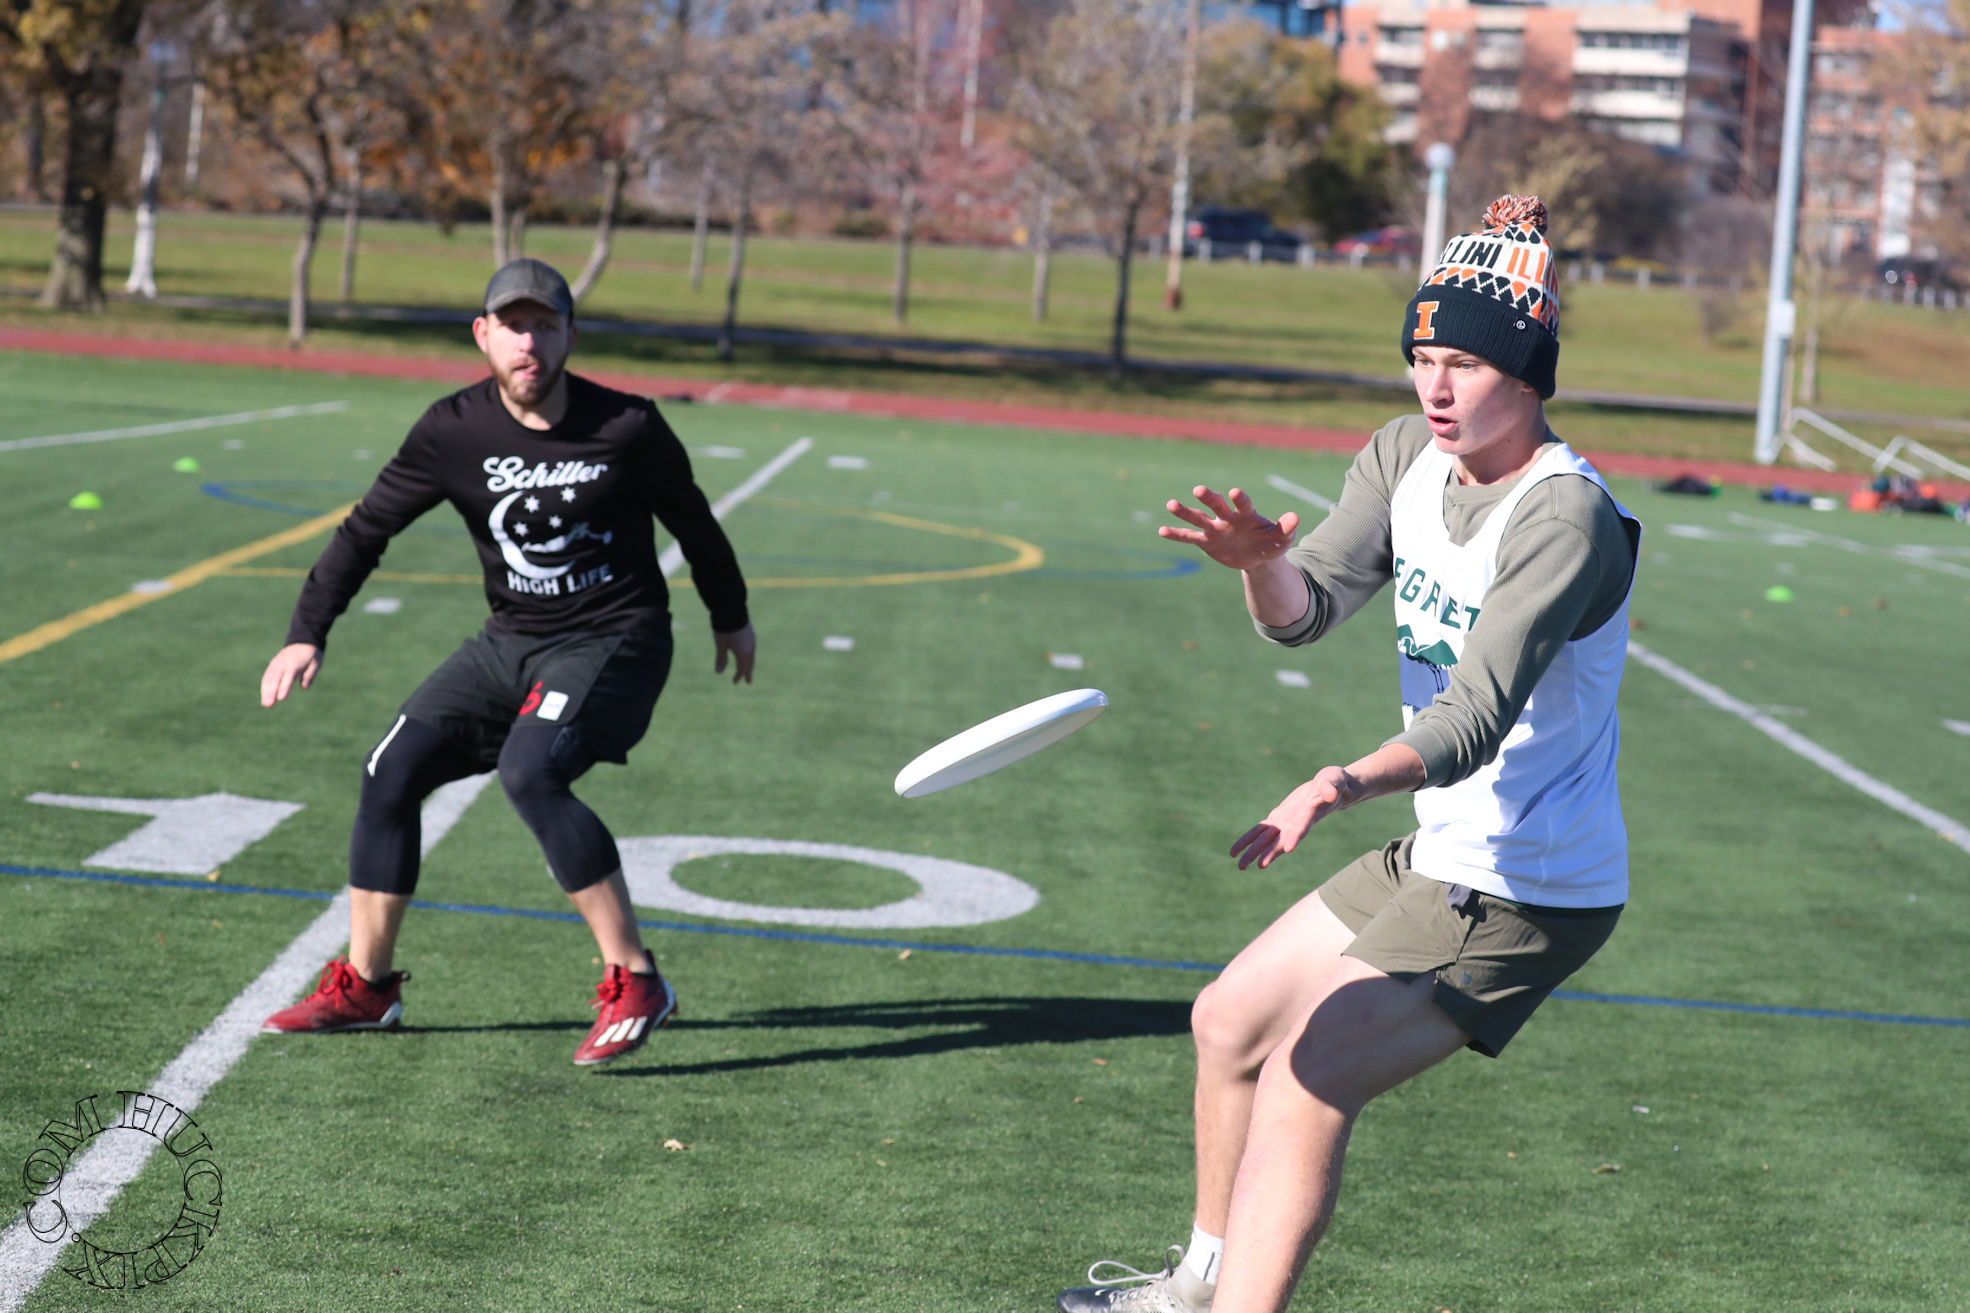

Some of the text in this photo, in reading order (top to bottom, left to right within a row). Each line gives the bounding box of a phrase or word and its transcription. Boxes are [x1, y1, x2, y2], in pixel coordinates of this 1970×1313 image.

[483, 456, 609, 493] Schiller
[506, 563, 614, 595] HIGH LIFE
